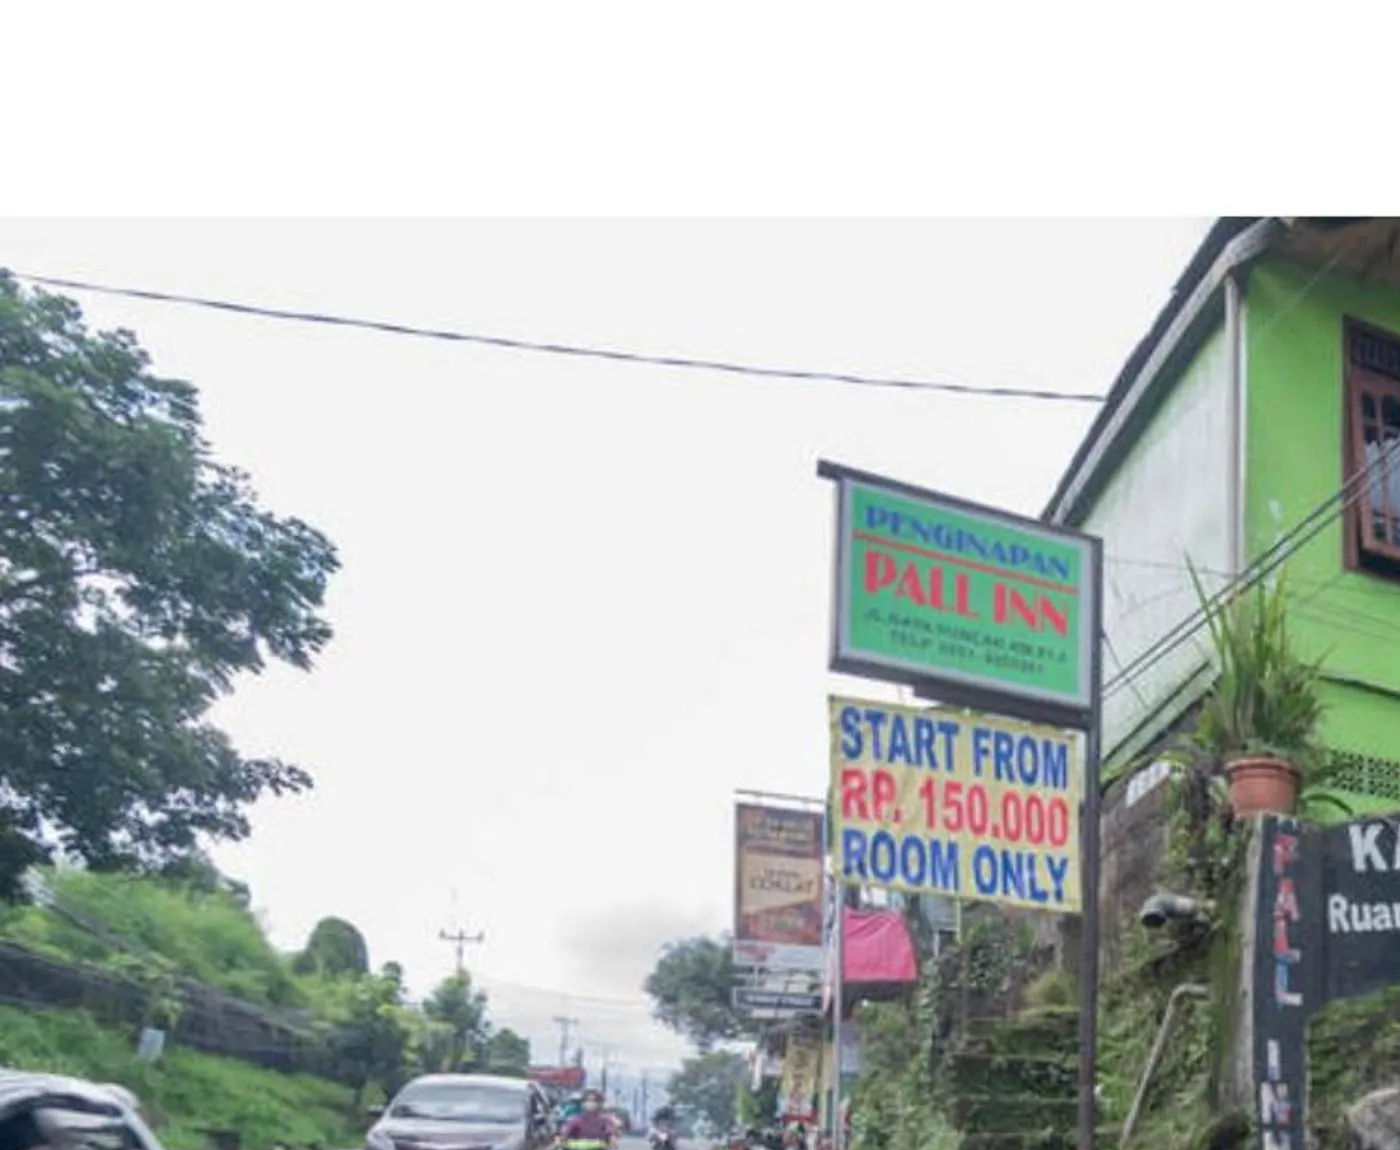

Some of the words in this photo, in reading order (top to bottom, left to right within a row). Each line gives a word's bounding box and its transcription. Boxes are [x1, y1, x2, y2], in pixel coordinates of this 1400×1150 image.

[864, 505, 1069, 580] PENGINAPAN
[862, 550, 980, 618] PALL
[993, 581, 1067, 638] INN
[840, 706, 960, 774] START
[972, 725, 1069, 791] FROM
[840, 768, 903, 824] RP.
[918, 775, 1070, 848] 150.000
[841, 827, 960, 893] ROOM
[972, 843, 1069, 904] ONLY
